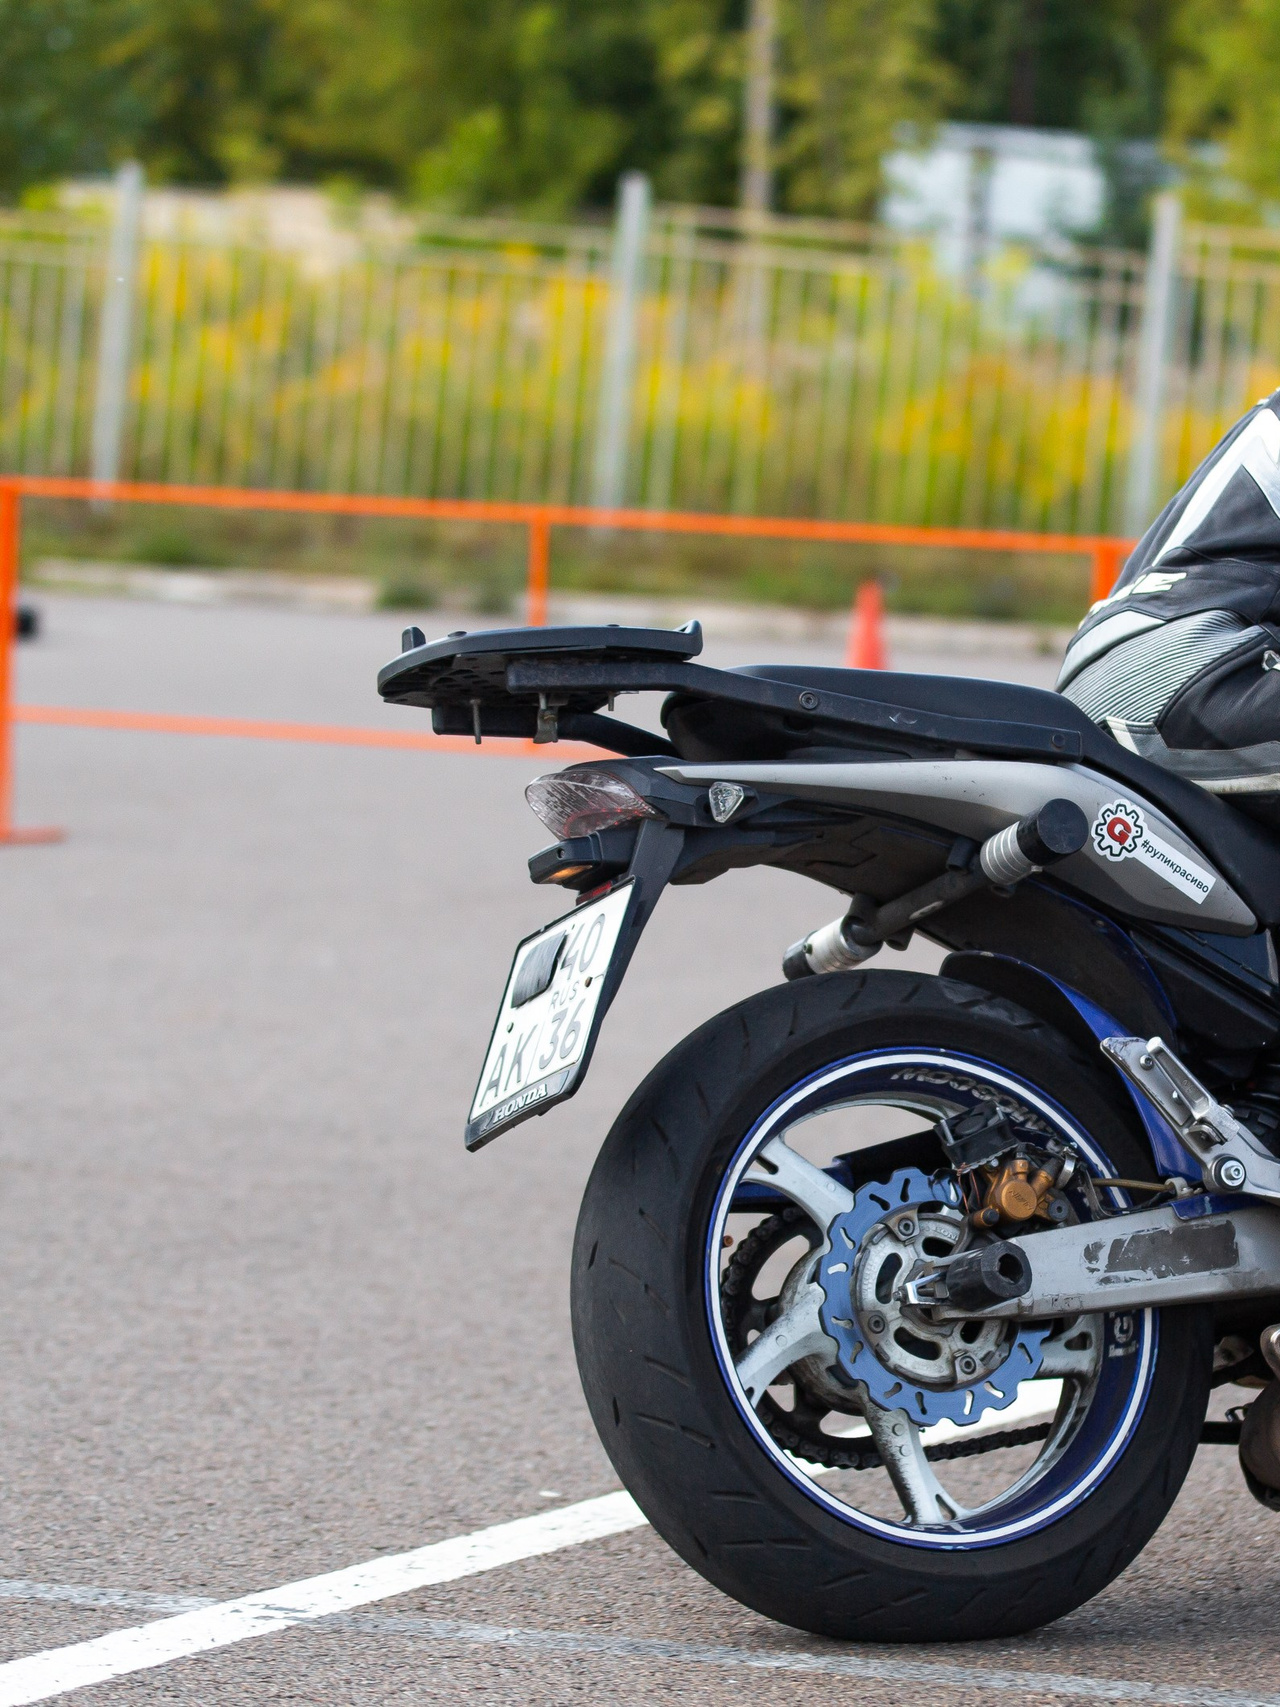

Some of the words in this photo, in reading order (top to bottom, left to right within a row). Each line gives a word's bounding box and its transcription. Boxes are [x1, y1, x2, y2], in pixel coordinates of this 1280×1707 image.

[1140, 838, 1210, 894] #руликрасиво
[549, 981, 580, 1010] RUS
[538, 998, 587, 1070] 36
[492, 1083, 549, 1124] HONDA
